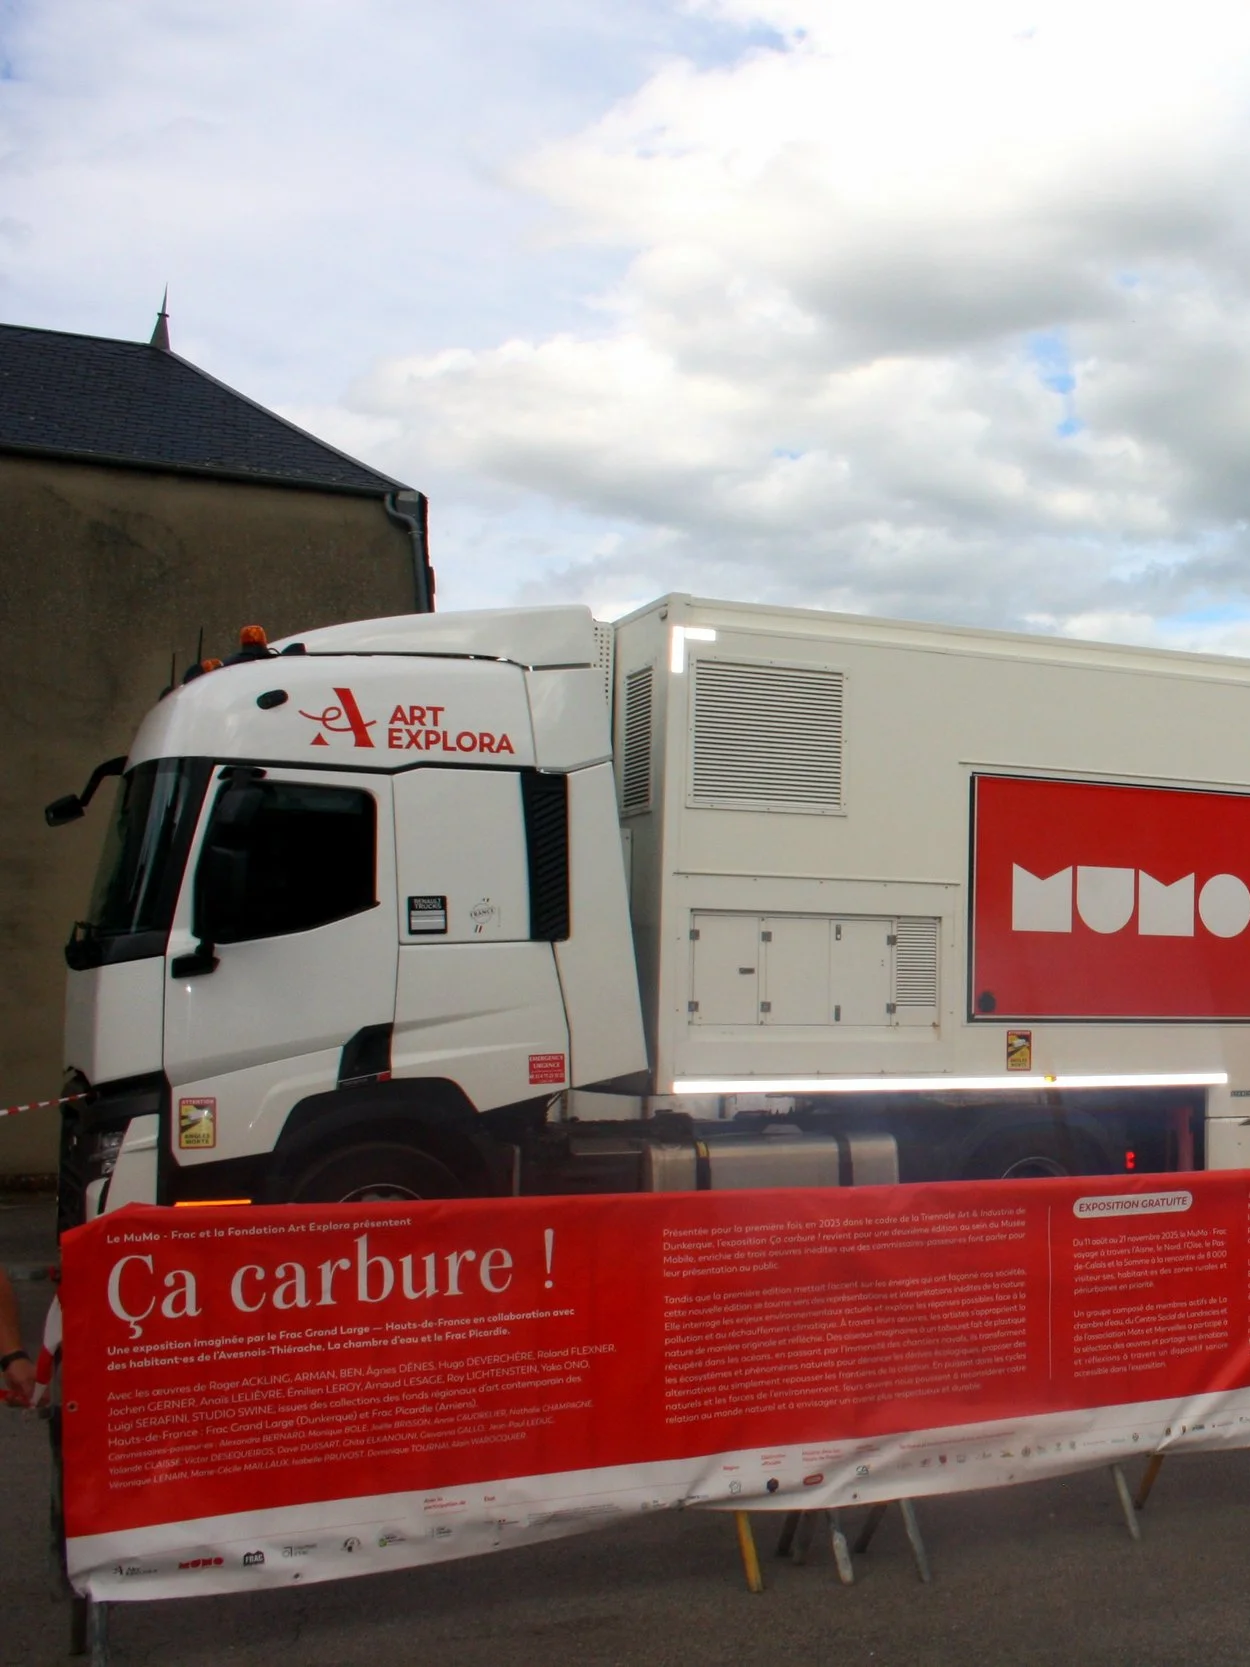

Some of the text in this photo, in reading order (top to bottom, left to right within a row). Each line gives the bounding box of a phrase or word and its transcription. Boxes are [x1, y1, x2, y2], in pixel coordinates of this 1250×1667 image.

[389, 705, 444, 727] ART
[388, 728, 515, 754] EXPLORA
[1078, 1196, 1188, 1213] EXPOSITION GRATUITE
[106, 1235, 121, 1244] Le
[123, 1232, 161, 1243] MuMo
[171, 1231, 197, 1240] Frac
[198, 1229, 211, 1238] et
[214, 1228, 225, 1237] la
[227, 1224, 286, 1236] Fondation
[287, 1224, 306, 1233] Art
[308, 1221, 351, 1233] Explora
[351, 1218, 412, 1232] présentent
[107, 1228, 555, 1339] Ça carbure !
[107, 1347, 131, 1355] Une
[132, 1340, 191, 1354] exposition
[193, 1335, 245, 1348] imaginée
[246, 1335, 266, 1345] par
[267, 1333, 278, 1341] le
[279, 1332, 303, 1340] Frac
[305, 1327, 338, 1338] Grand
[340, 1326, 370, 1336] Large
[386, 1318, 473, 1331] Hauts-de-France
[486, 1310, 551, 1323] collaboration
[552, 1309, 576, 1317] avec
[107, 1361, 127, 1370] des
[196, 1352, 213, 1362] de
[327, 1341, 341, 1350] La
[342, 1337, 390, 1349] chambre
[420, 1333, 432, 1343] et
[433, 1332, 444, 1341] le
[444, 1331, 468, 1340] Frac
[468, 1327, 511, 1338] Picardie.
[107, 1419, 134, 1431] Luigi
[191, 1409, 236, 1422] STUDIO
[278, 1404, 308, 1413] issues
[310, 1401, 328, 1410] des
[329, 1396, 381, 1408] collections
[383, 1394, 401, 1403] des
[401, 1390, 430, 1401] fonds
[430, 1387, 477, 1399] régionaux
[500, 1376, 564, 1391] contemporain
[565, 1375, 583, 1384] des
